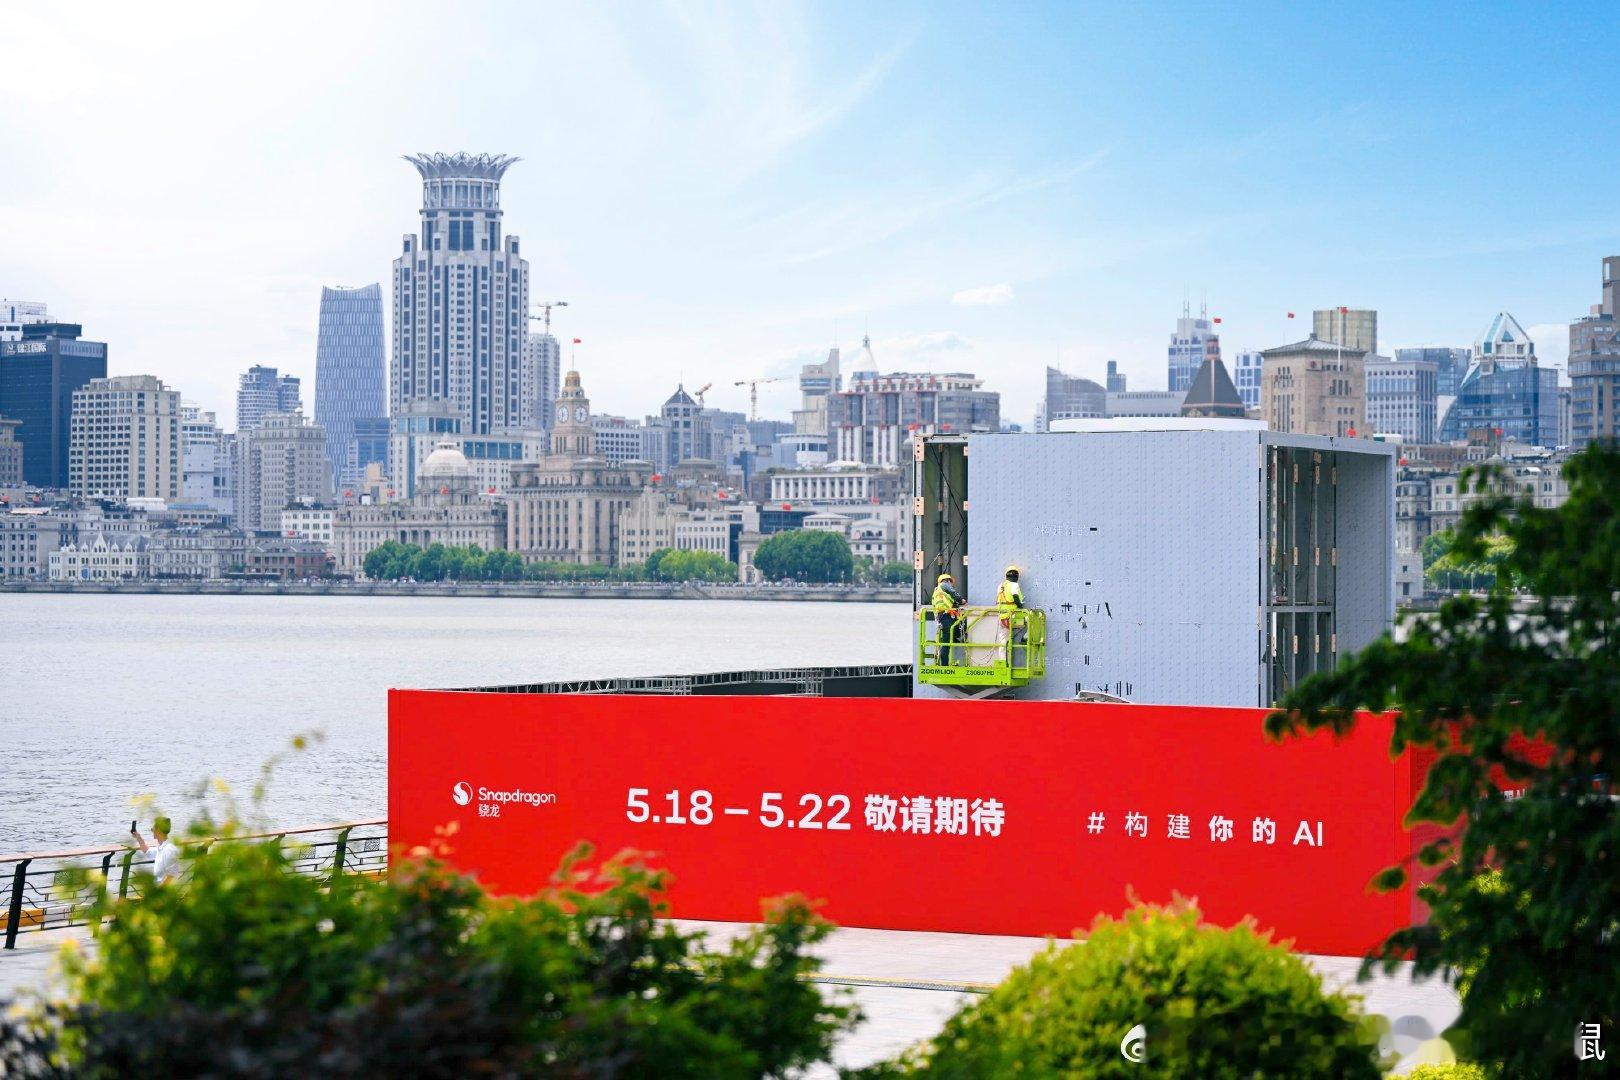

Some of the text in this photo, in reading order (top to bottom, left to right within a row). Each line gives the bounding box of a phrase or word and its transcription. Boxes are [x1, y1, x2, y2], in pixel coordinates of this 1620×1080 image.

[478, 787, 556, 806] Snapdragon
[478, 804, 500, 817] 骁龙
[626, 788, 713, 825] 5.18
[759, 793, 851, 830] 5.22
[864, 794, 1005, 837] 敬请期待
